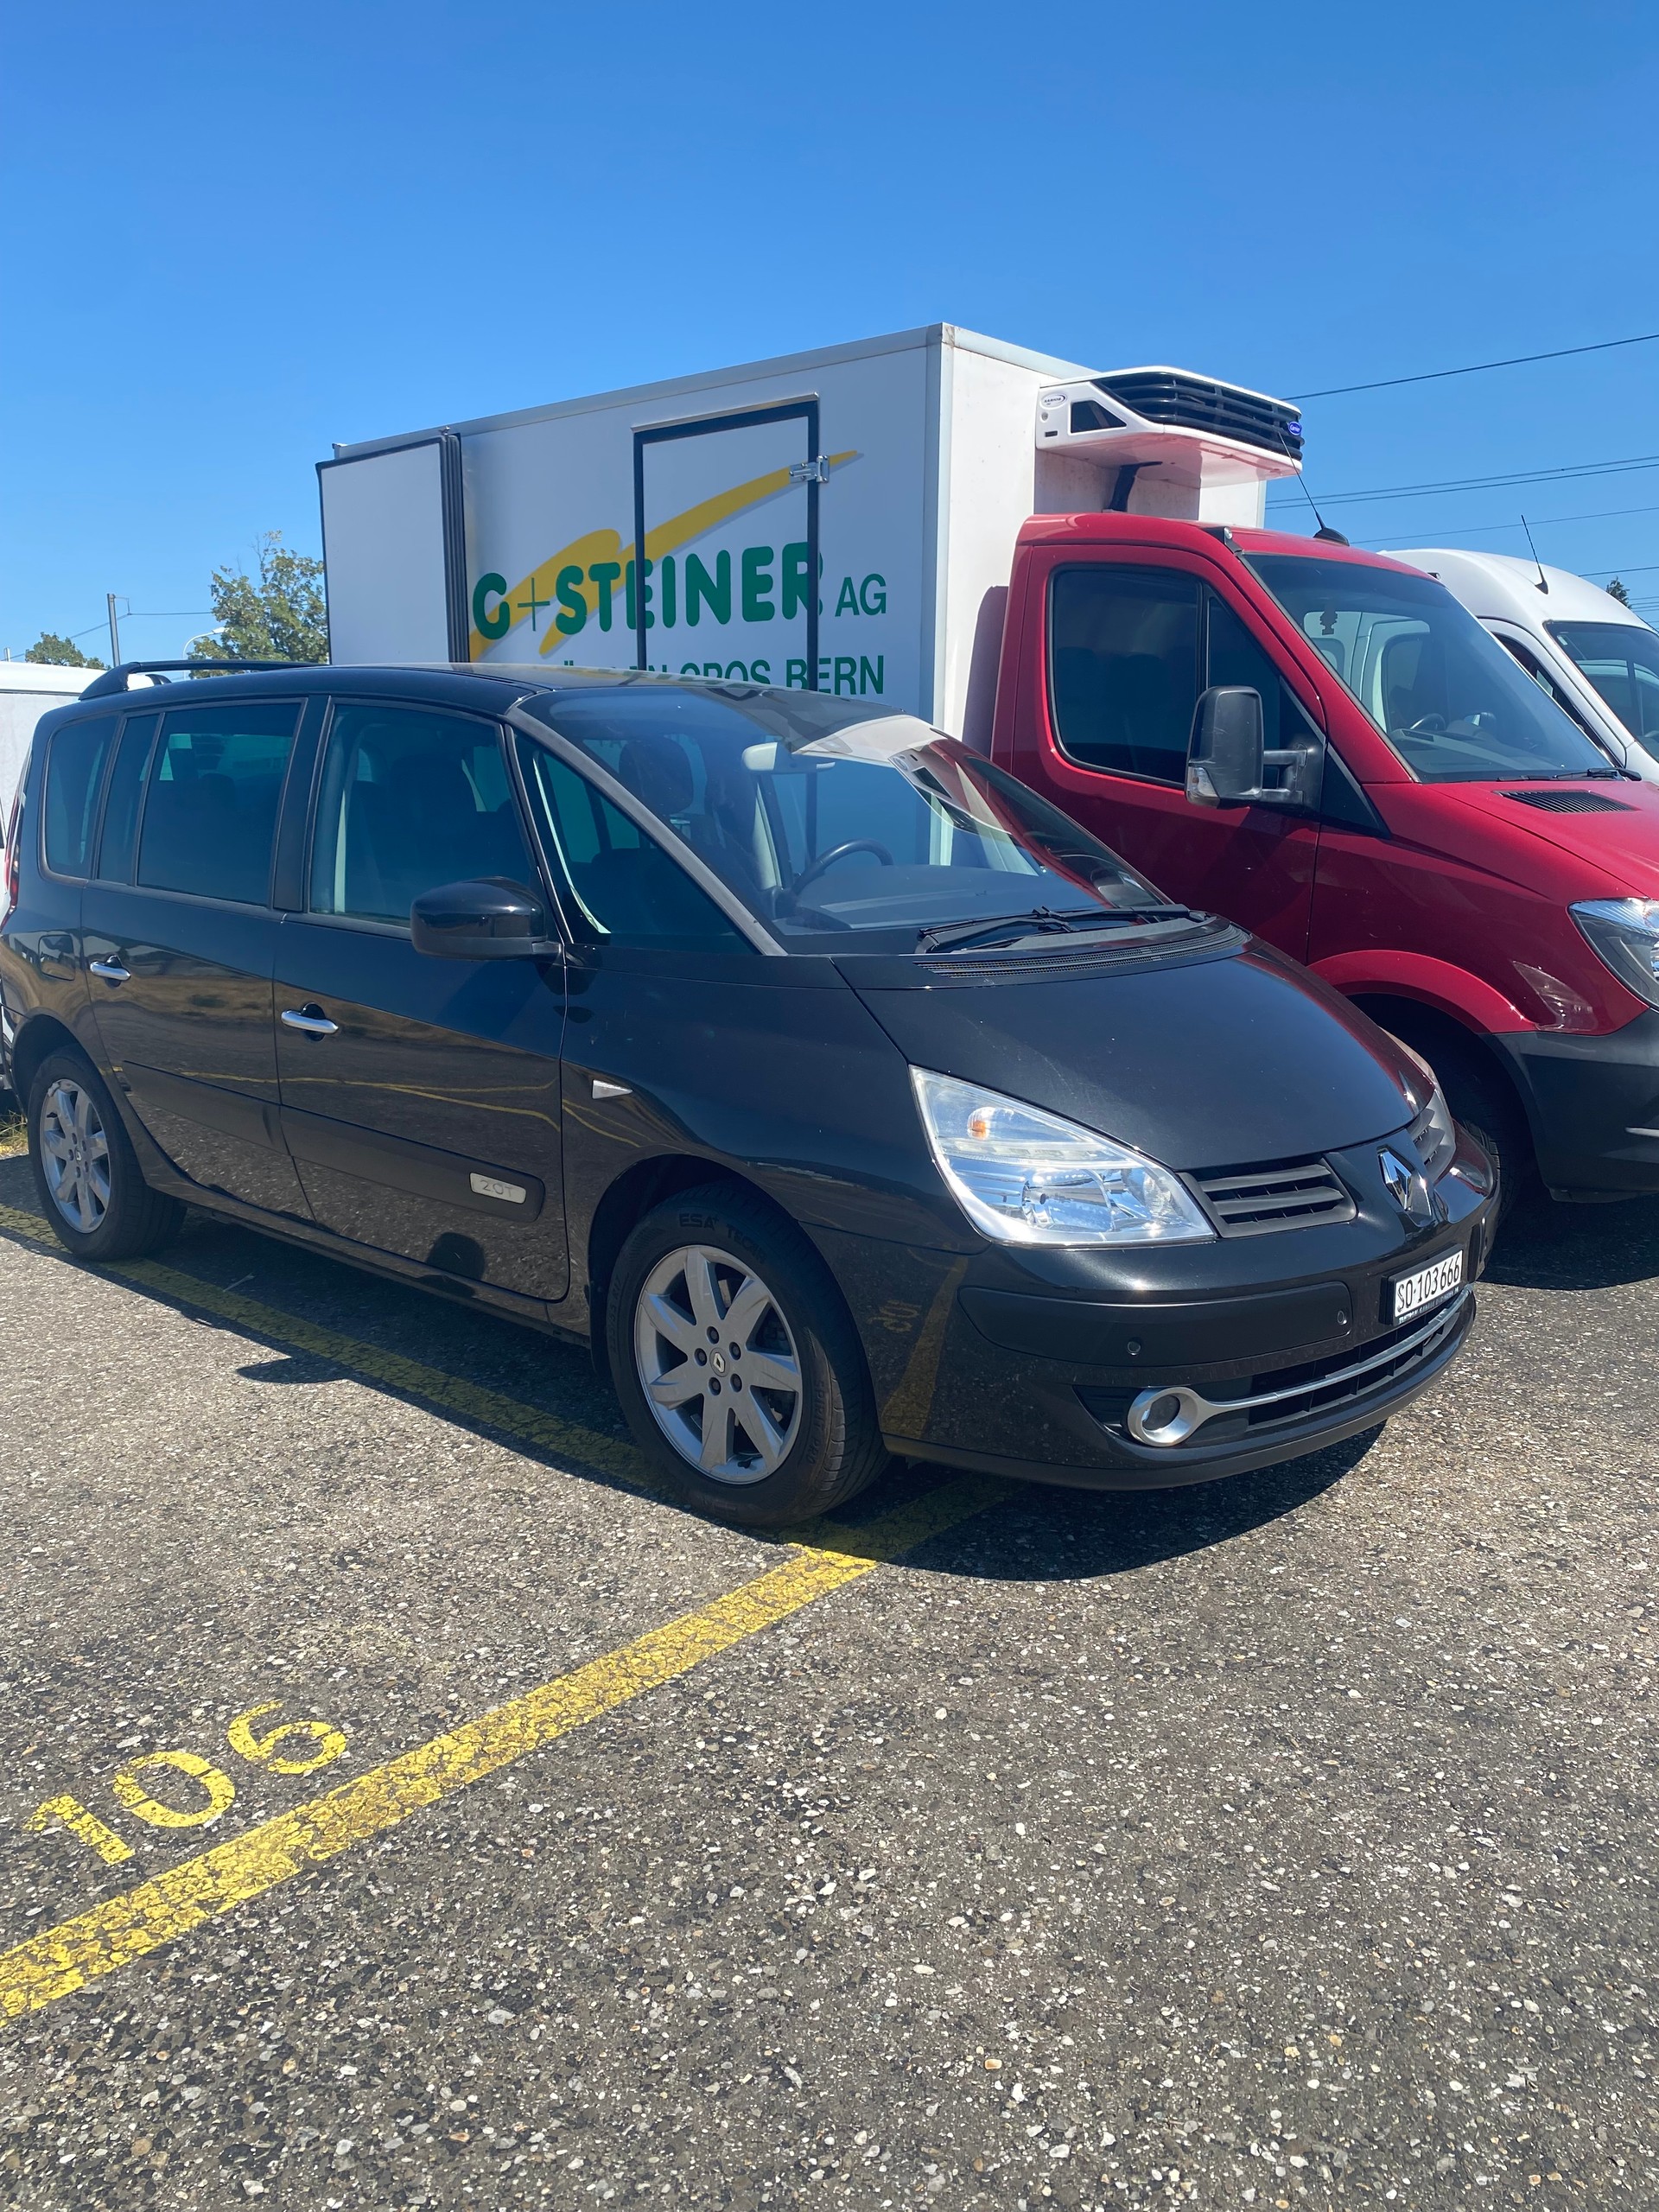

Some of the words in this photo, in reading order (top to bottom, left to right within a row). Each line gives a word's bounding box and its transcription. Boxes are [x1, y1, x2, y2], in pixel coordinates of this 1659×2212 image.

[835, 573, 887, 617] AG
[785, 655, 884, 695] BERN
[22, 1699, 347, 1866] 106
